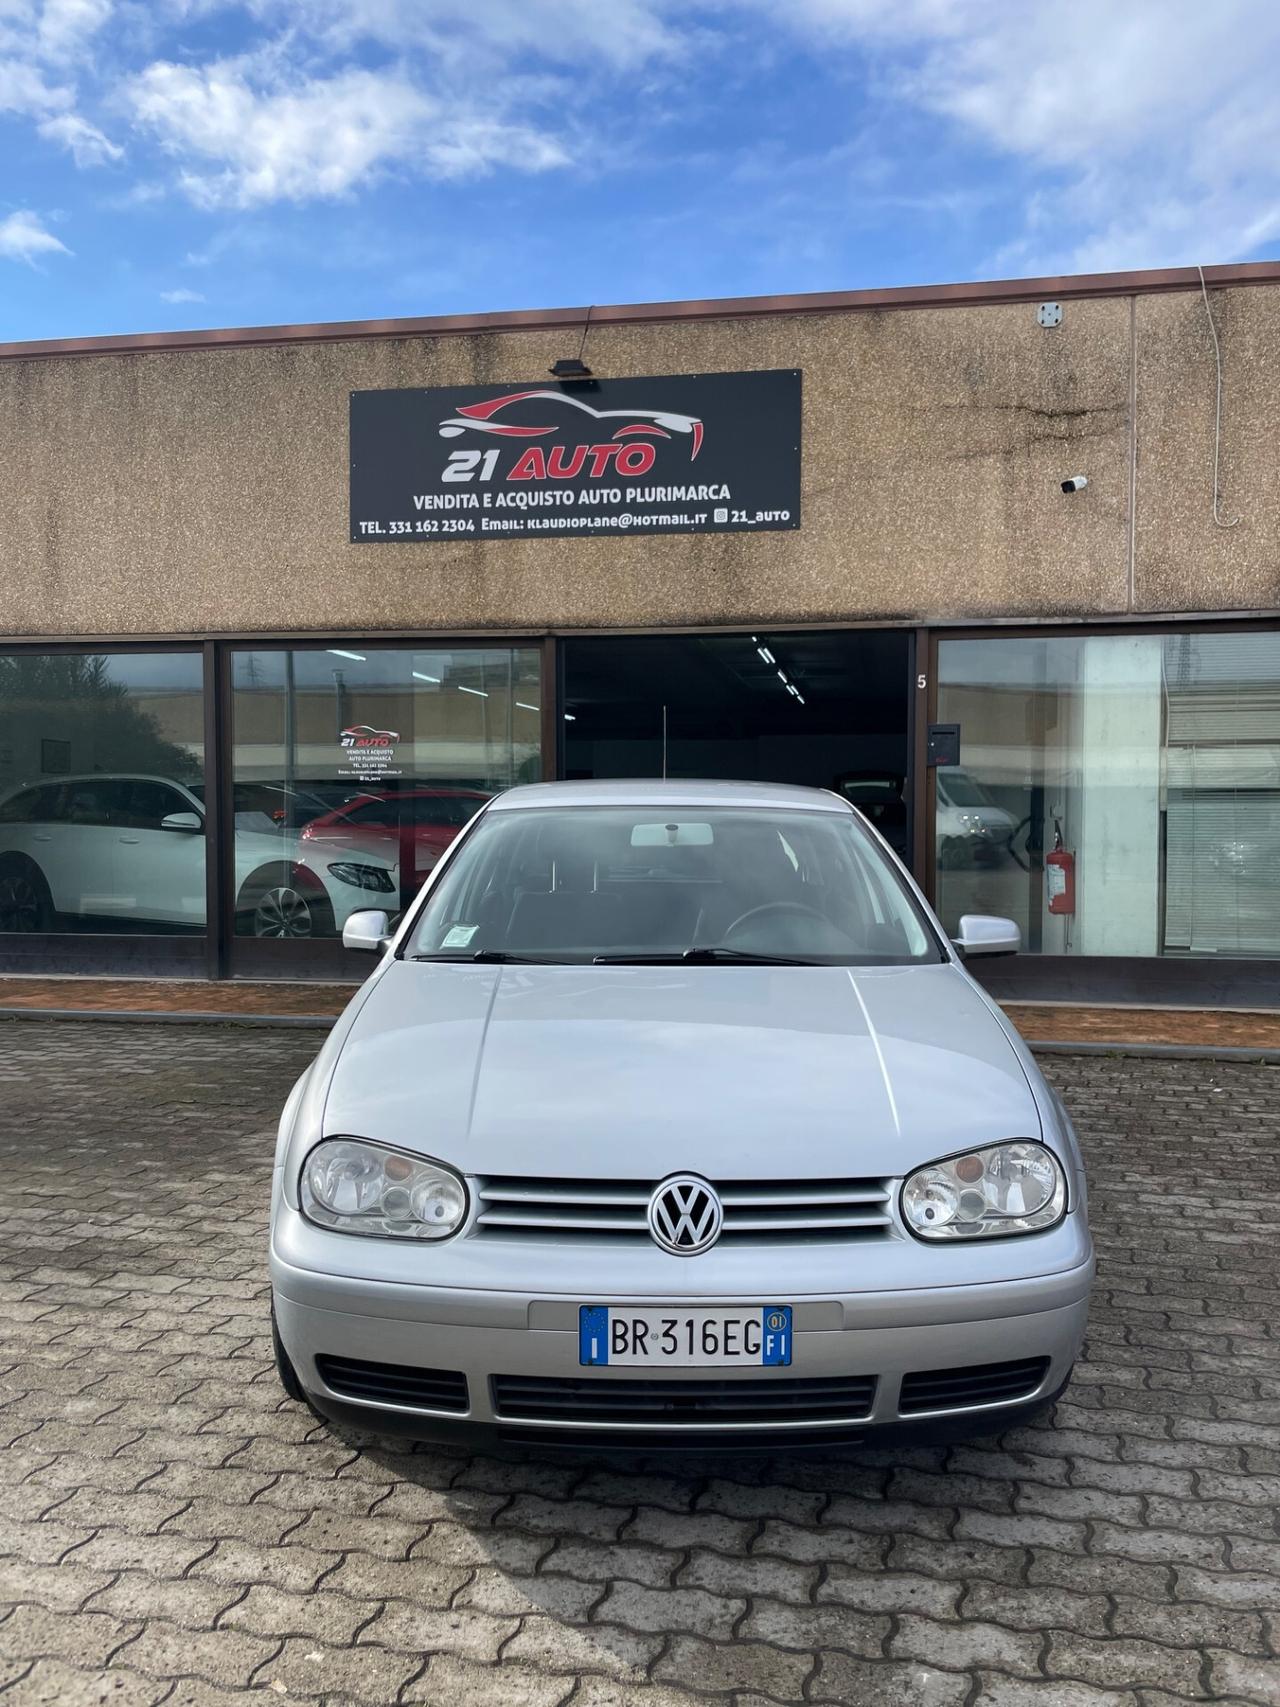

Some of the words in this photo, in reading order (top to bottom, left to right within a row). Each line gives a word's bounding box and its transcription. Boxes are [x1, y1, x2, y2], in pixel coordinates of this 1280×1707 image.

[441, 449, 501, 483] 21
[505, 443, 656, 481] AUTO
[413, 493, 480, 510] VENDITA
[482, 493, 492, 508] E
[495, 490, 575, 510] ACQUISTO
[578, 488, 622, 505] AUTO
[626, 484, 731, 503] PLURIMARCA
[359, 520, 386, 534] TEL.
[389, 520, 413, 534] 331
[415, 520, 439, 533] 162
[442, 519, 475, 532] 2304
[917, 674, 927, 689] 5
[341, 738, 355, 746] 21
[356, 738, 389, 747] AUTO
